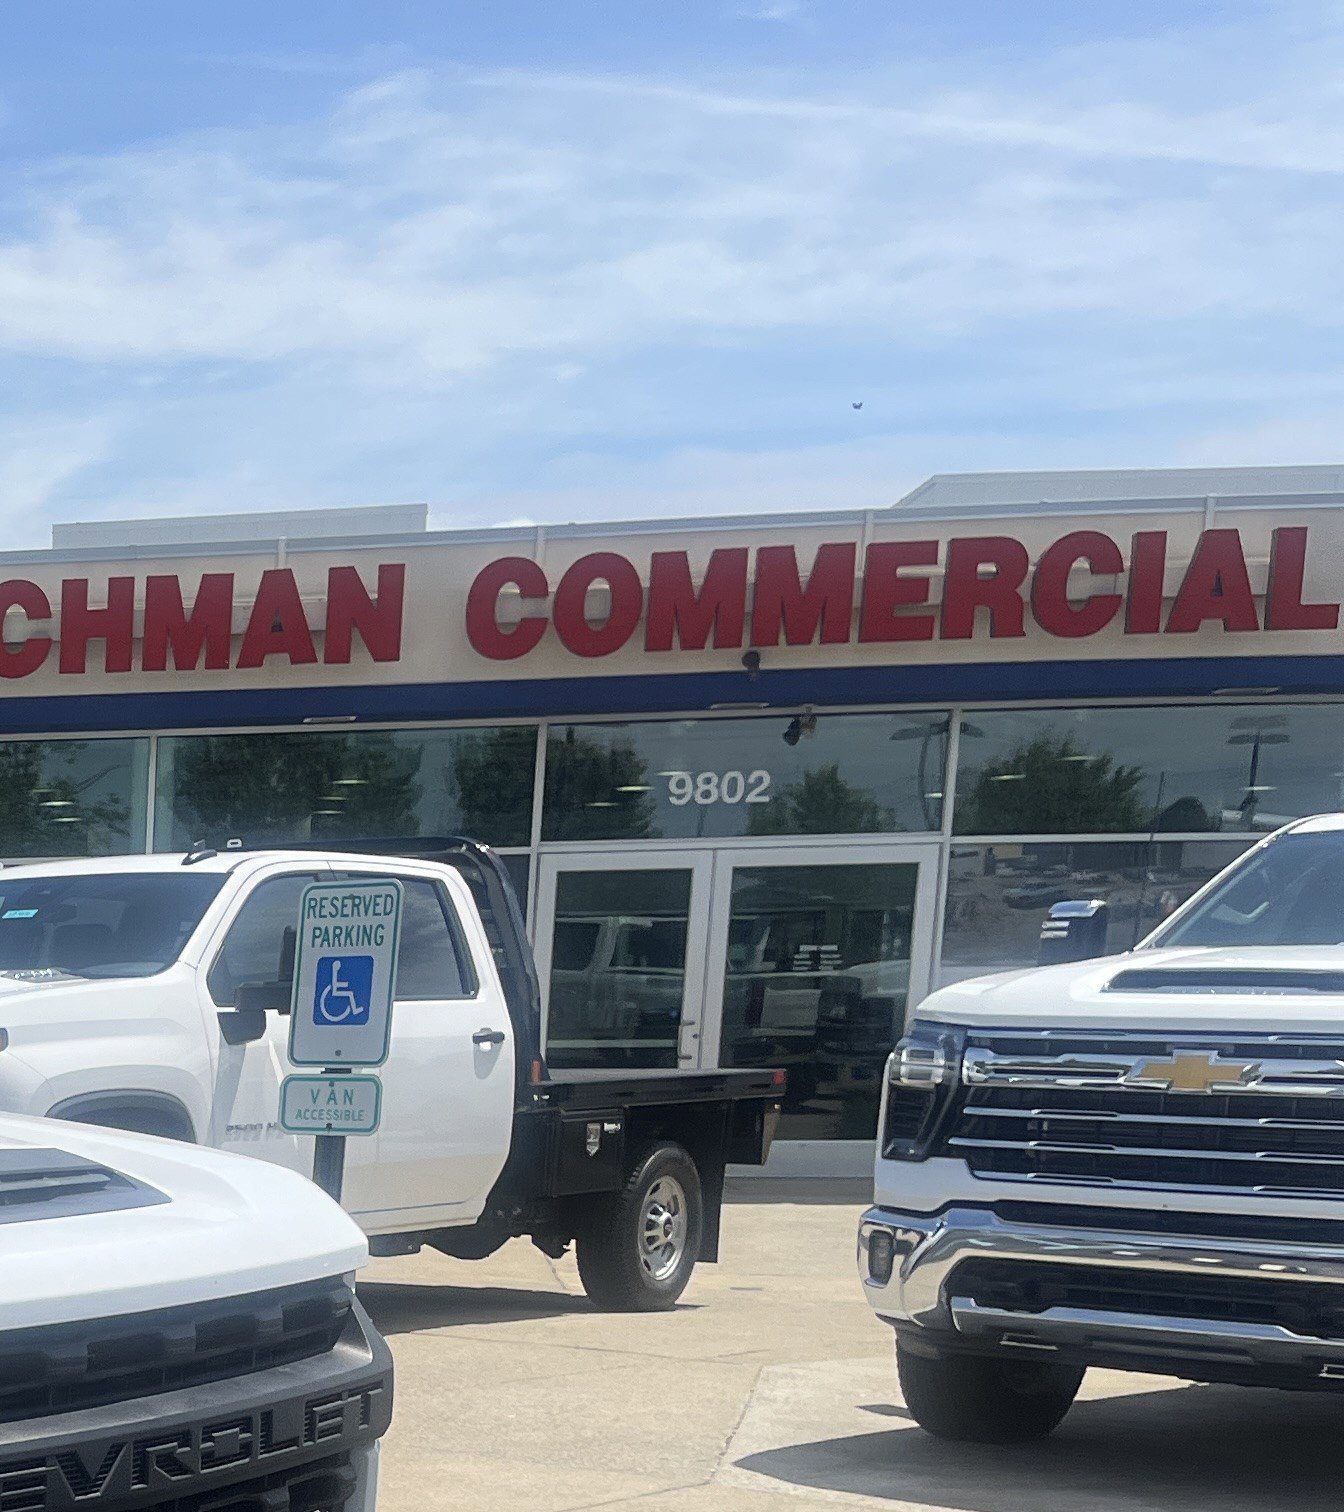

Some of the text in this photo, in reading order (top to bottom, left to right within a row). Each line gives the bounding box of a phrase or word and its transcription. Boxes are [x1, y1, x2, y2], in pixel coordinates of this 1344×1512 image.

[466, 526, 1340, 661] COMMERCIAL
[668, 769, 771, 806] 9802
[307, 893, 394, 919] RESERVED
[311, 923, 385, 948] PARKING
[310, 1087, 354, 1105] VAN
[295, 1108, 365, 1121] ACCESSIBLE
